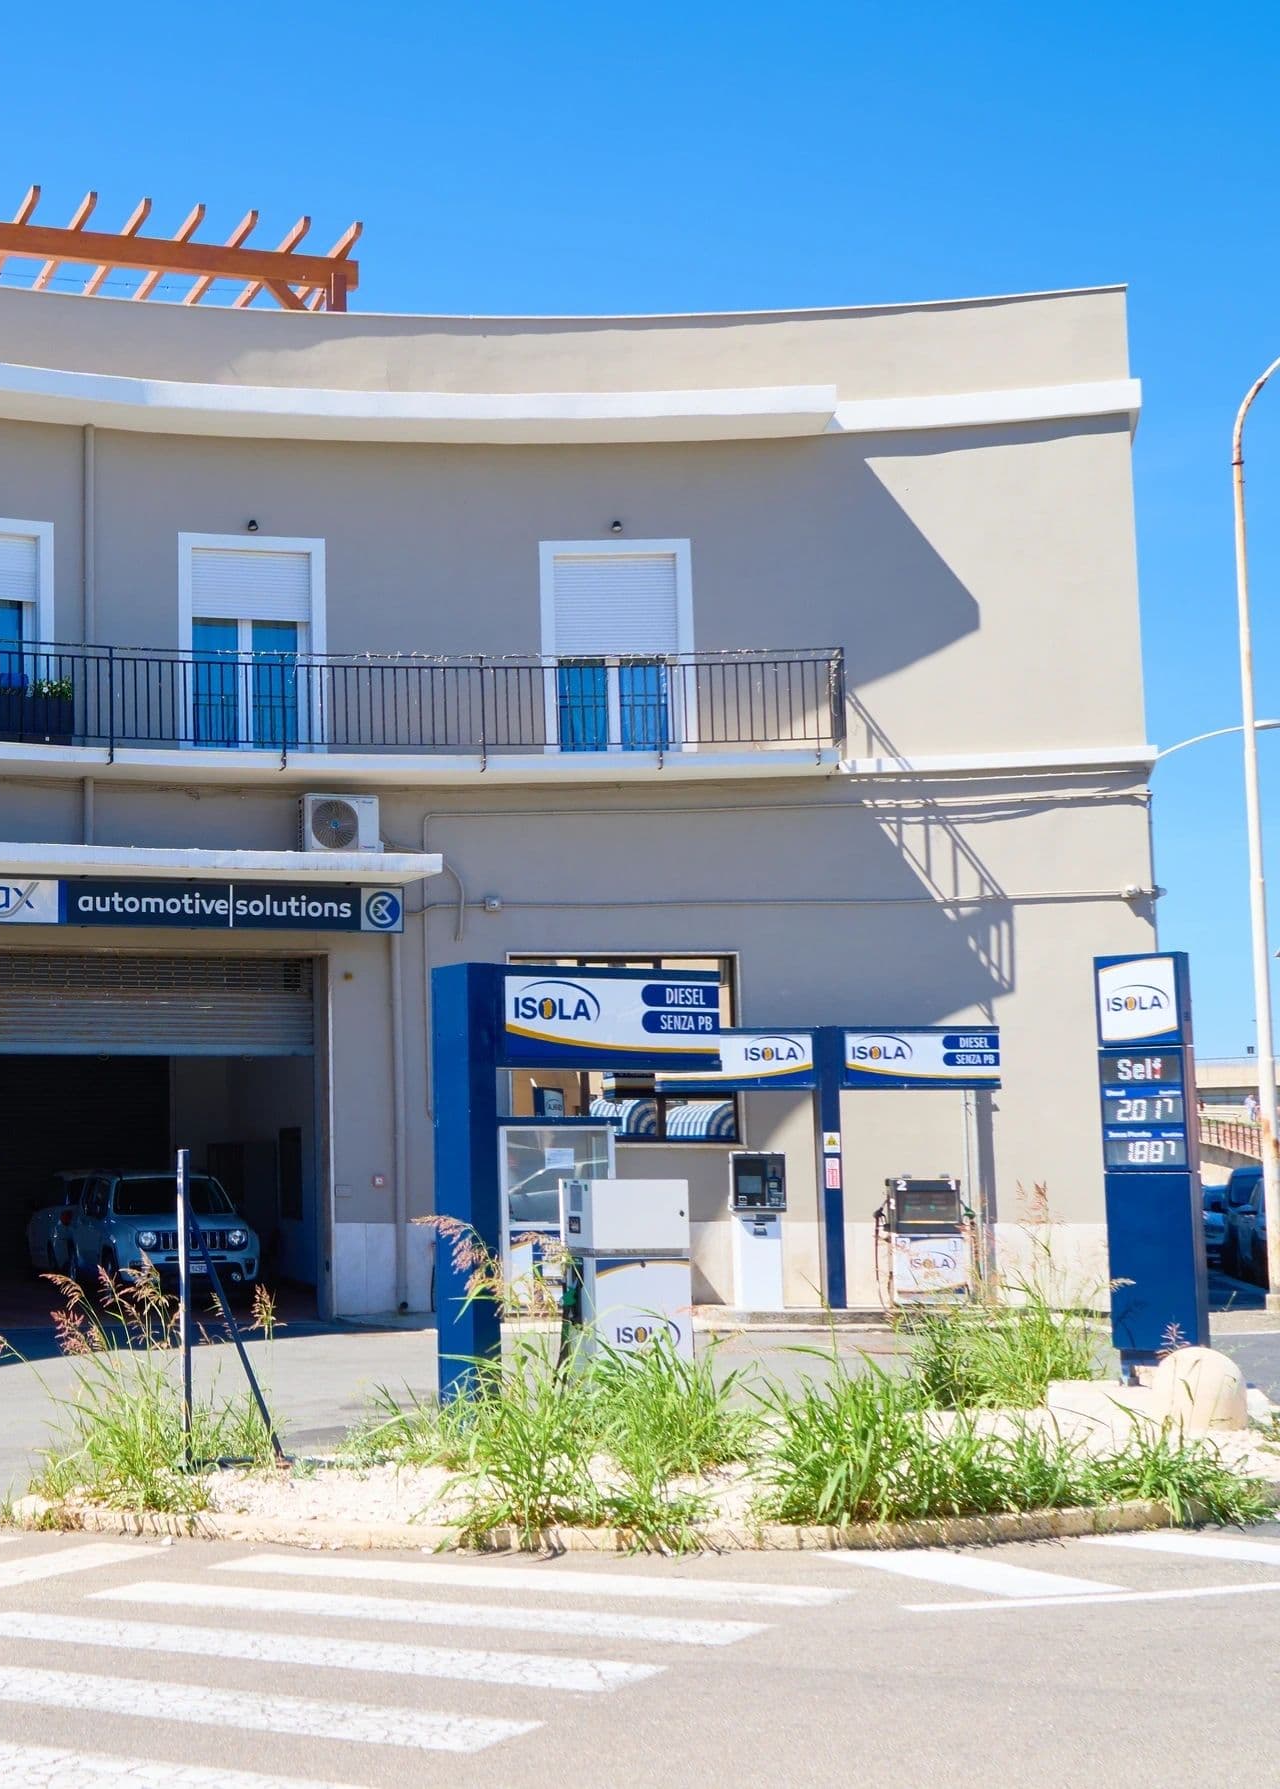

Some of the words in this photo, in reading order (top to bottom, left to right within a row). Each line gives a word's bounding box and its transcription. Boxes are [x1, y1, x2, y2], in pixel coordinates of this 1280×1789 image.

[77, 891, 228, 916] automotive
[235, 892, 352, 919] solutions
[665, 987, 706, 1006] DIESEL
[1106, 995, 1163, 1012] ISOLA
[514, 997, 592, 1021] ISOLA
[660, 1014, 695, 1031] SENZA
[698, 1016, 713, 1032] PB
[959, 1036, 990, 1049] DIESEL
[744, 1046, 799, 1062] ISOLA
[851, 1045, 907, 1061] ISOLA
[955, 1053, 982, 1065] SENZA
[983, 1054, 995, 1065] PB
[896, 1180, 908, 1191] 2
[948, 1180, 957, 1190] 1
